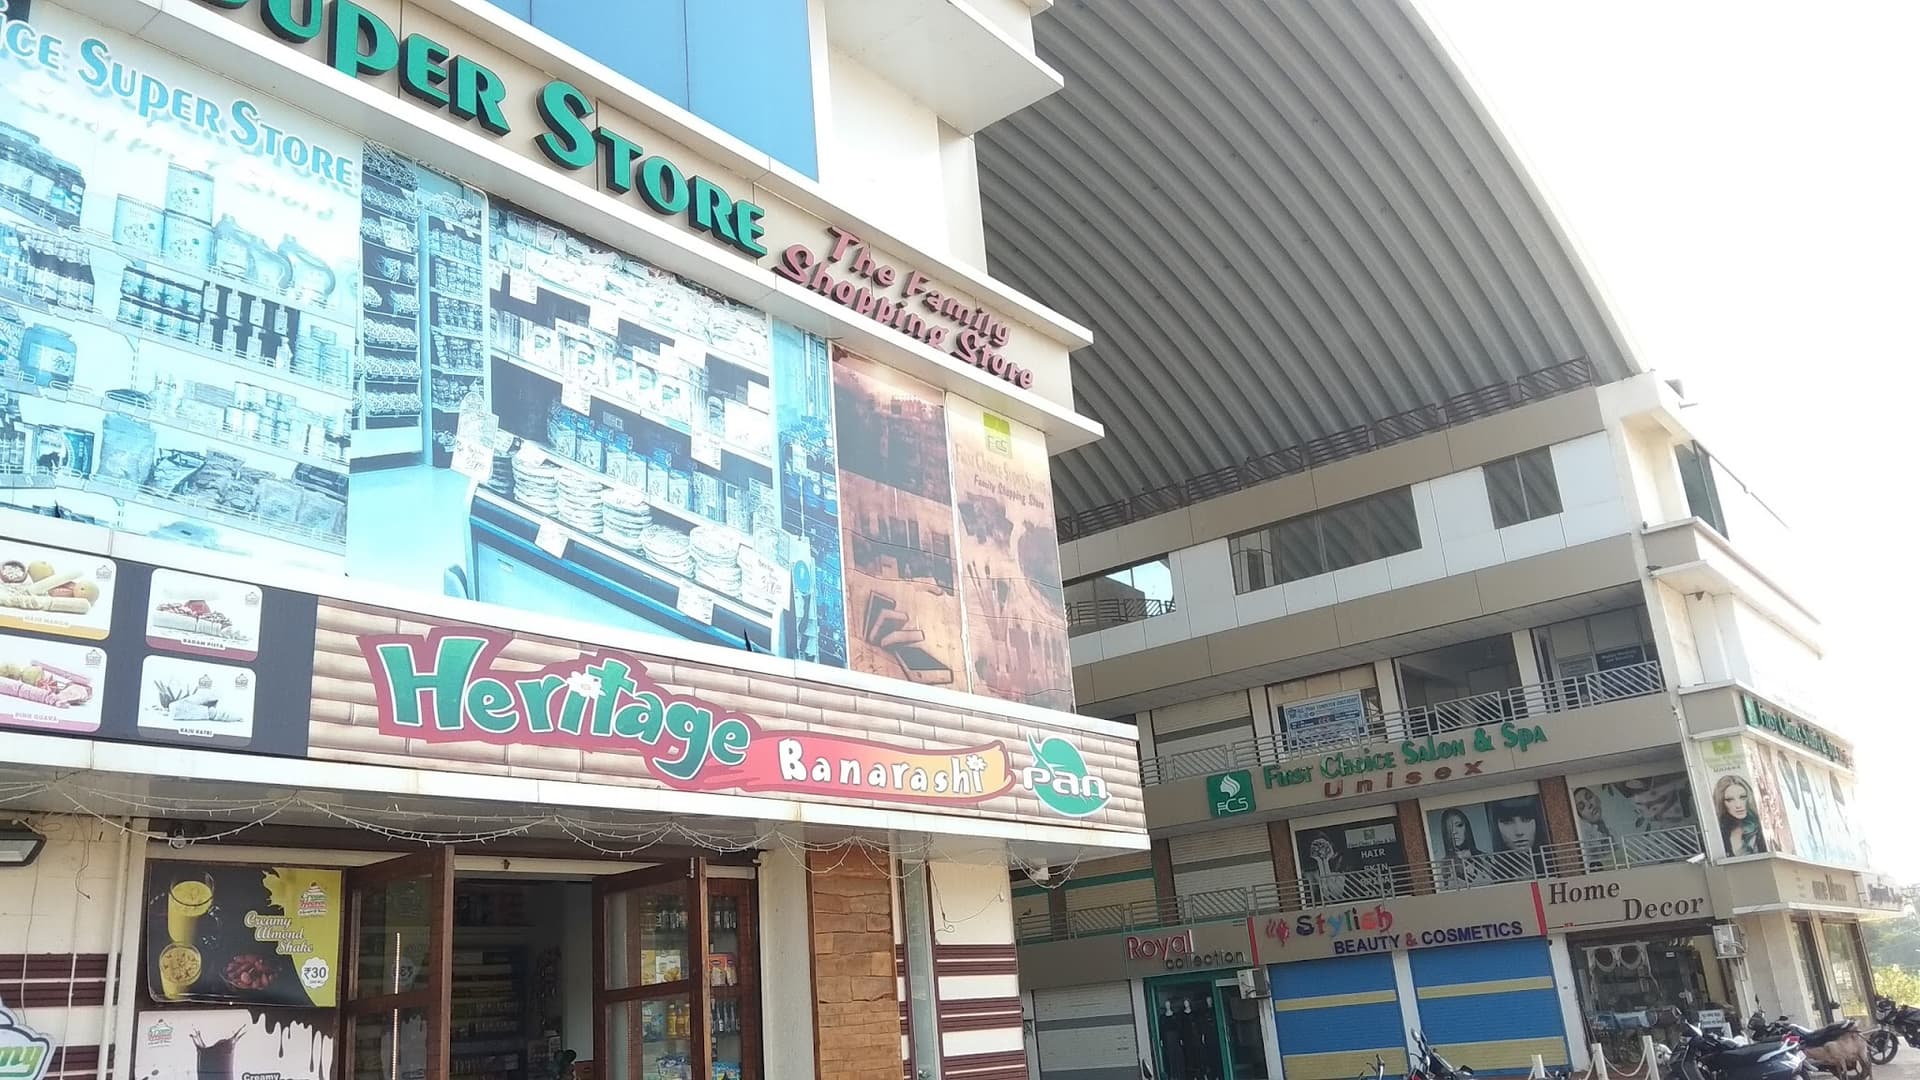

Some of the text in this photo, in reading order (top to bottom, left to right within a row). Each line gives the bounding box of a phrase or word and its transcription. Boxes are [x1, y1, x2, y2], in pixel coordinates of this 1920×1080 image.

[78, 38, 221, 133] SUPER
[230, 99, 354, 187] STORE
[200, 0, 768, 259] UPER STORE
[827, 225, 1012, 348] The Family
[772, 243, 1036, 390] Shopping Store
[974, 474, 997, 493] Family
[376, 636, 750, 780] Heritage
[778, 737, 986, 795] Banarashi
[1262, 722, 1548, 790] First Choice Salon & Spa
[1216, 796, 1249, 817] FCS
[1360, 848, 1386, 859] HAIR
[1548, 881, 1620, 905] Home
[244, 911, 292, 929] Creamy
[1295, 904, 1394, 938] Stylish
[1623, 896, 1704, 921] Decor
[255, 927, 304, 941] Almond
[1126, 928, 1195, 961] Royal
[1334, 920, 1523, 955] BEAUTY & COSMETICS
[277, 940, 313, 954] Shake
[1165, 950, 1246, 970] collection
[303, 966, 327, 980] ₹30
